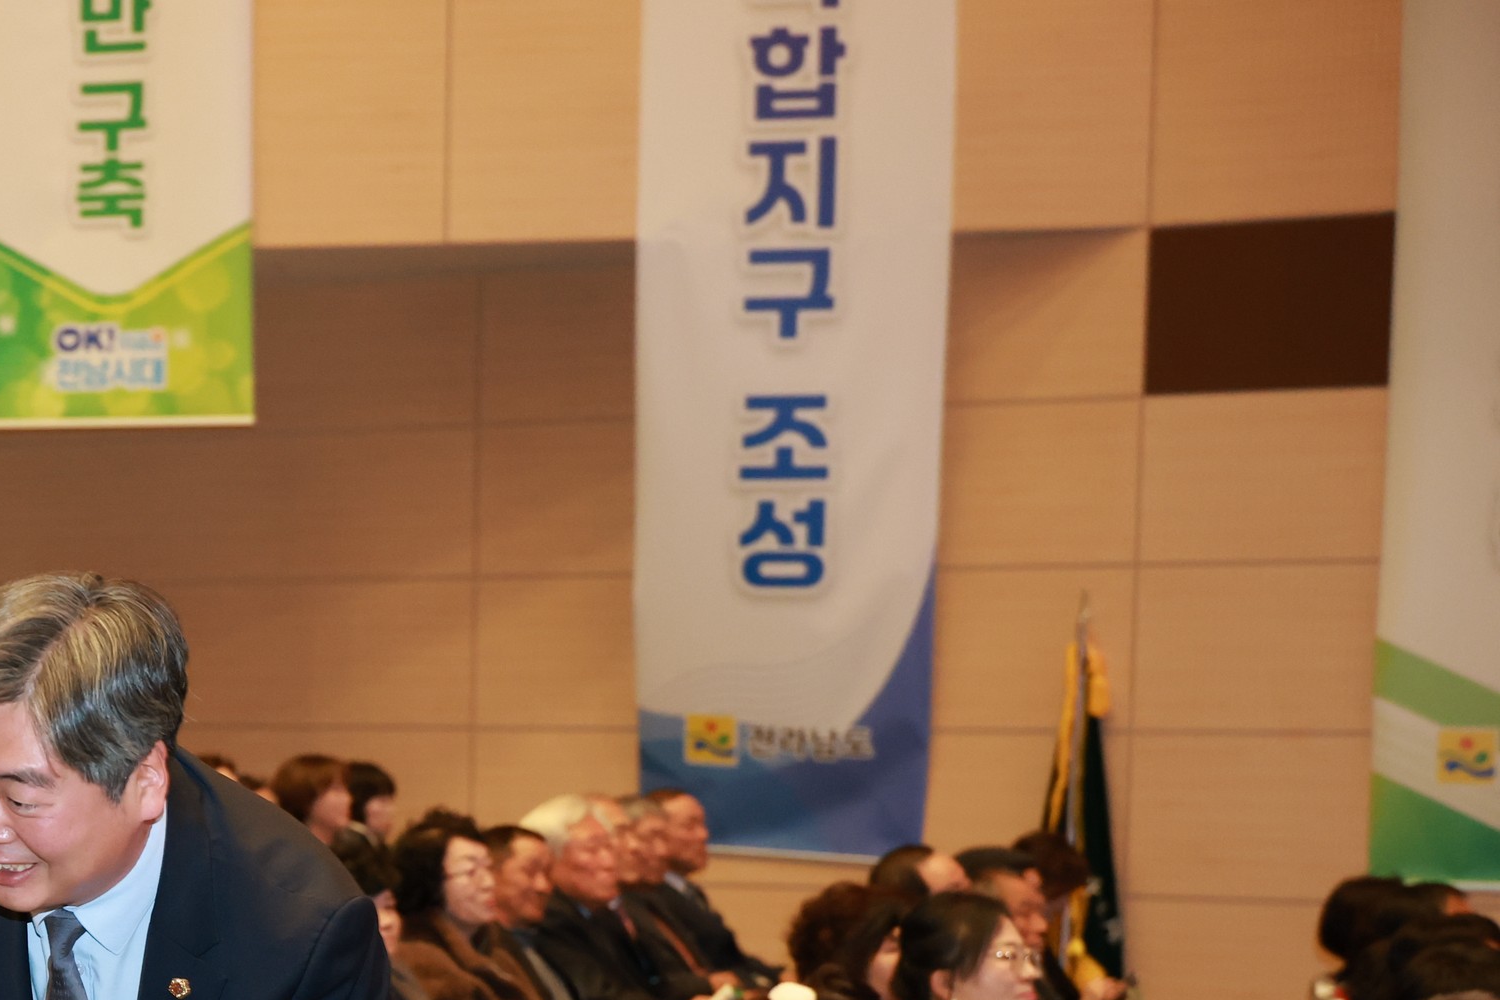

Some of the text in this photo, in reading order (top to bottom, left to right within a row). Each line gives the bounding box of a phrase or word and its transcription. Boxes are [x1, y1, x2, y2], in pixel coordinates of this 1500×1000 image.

[77, 82, 147, 229] 구축
[739, 0, 846, 588] 합지구 조성
